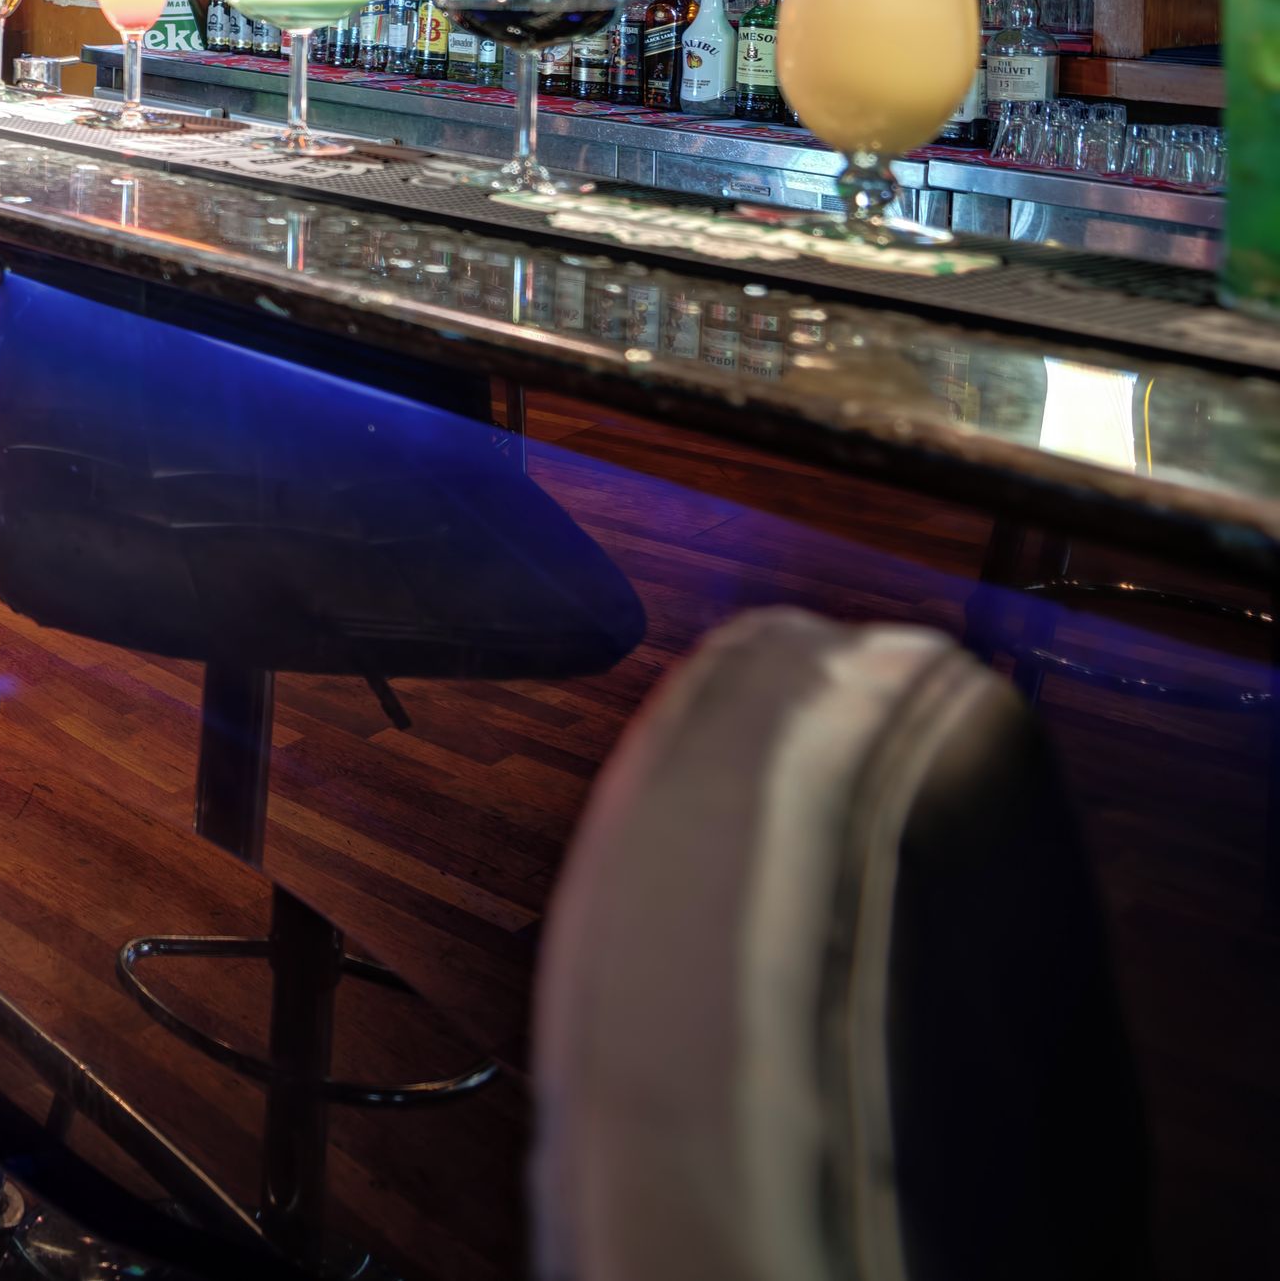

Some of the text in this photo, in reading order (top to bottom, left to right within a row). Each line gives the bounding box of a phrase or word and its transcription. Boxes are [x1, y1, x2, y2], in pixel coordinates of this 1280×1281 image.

[739, 32, 777, 43] AMESO
[682, 39, 720, 56] ALIBU
[999, 80, 1010, 88] 15
